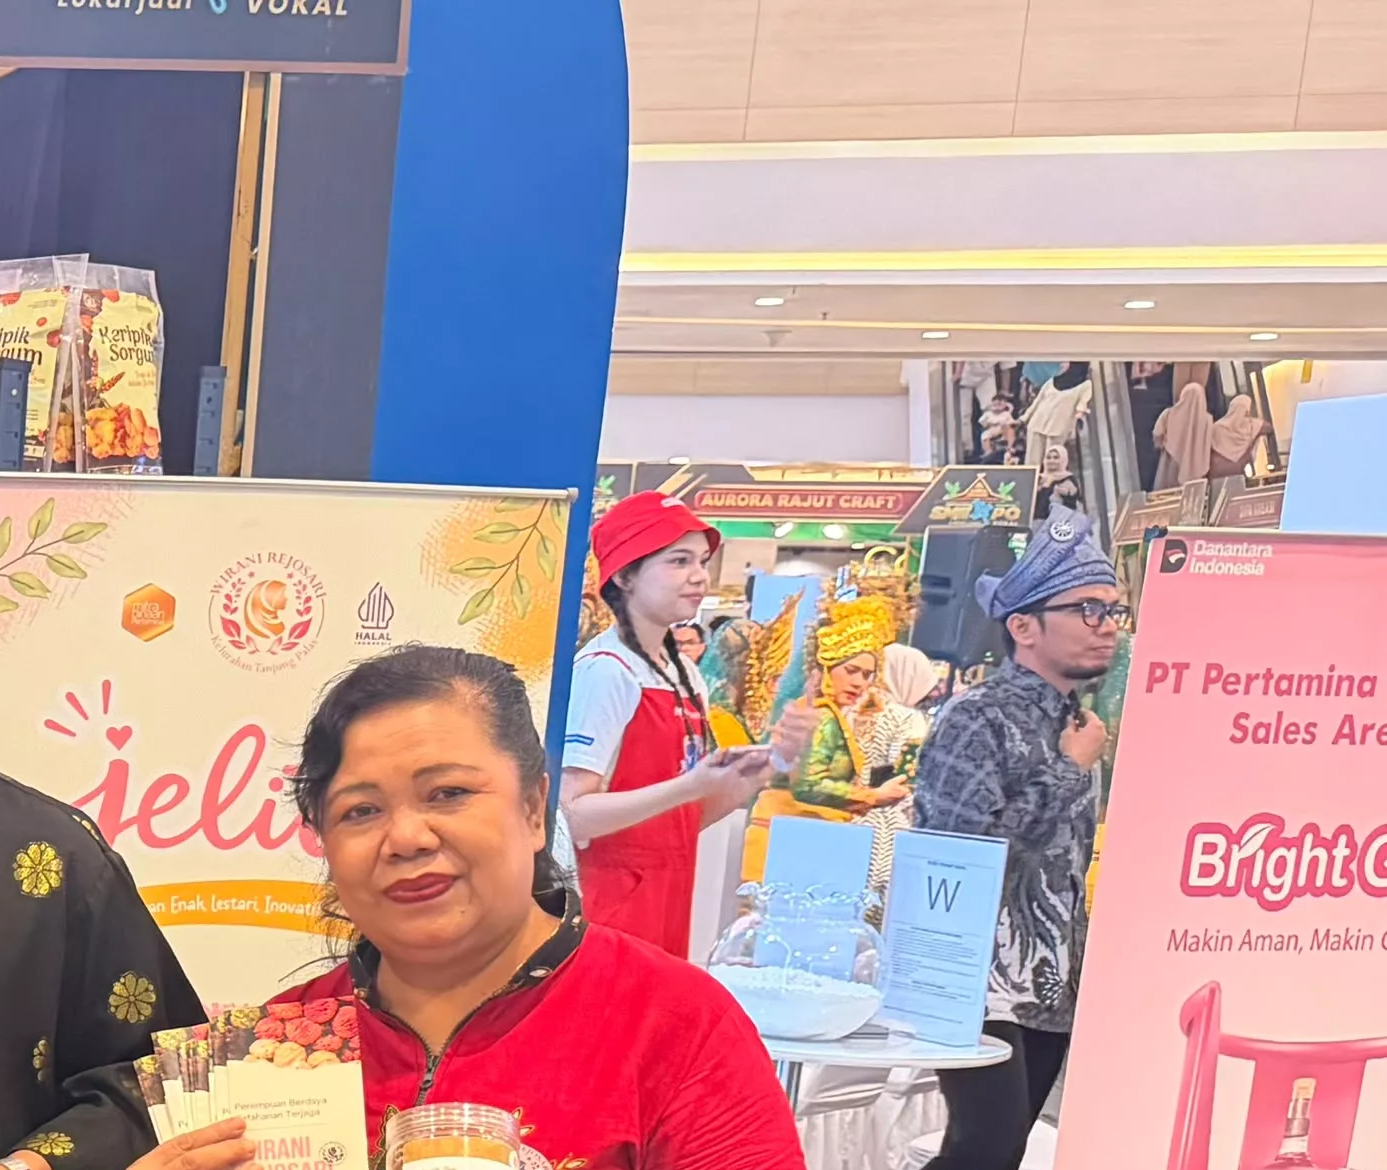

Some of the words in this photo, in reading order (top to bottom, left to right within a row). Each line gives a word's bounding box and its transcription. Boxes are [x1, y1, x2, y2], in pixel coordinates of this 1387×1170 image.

[701, 494, 774, 508] AURORA
[777, 494, 835, 508] RAJUT
[838, 495, 897, 509] CRAFT
[1193, 540, 1273, 558] Danantara
[210, 552, 264, 596] WIRANI
[267, 551, 328, 599] REJOSARI
[1189, 557, 1265, 576] Indonesia
[355, 632, 392, 642] HALAL
[1145, 661, 1190, 694] PT
[1202, 663, 1378, 698] Pertamina
[1229, 711, 1318, 745] Sales
[71, 724, 324, 857] jeli
[1185, 820, 1352, 905] Bright
[171, 894, 207, 914] Enak
[927, 875, 962, 913] W
[1167, 928, 1233, 953] Makin
[1238, 928, 1304, 955] Aman,
[1309, 927, 1375, 952] Makin
[255, 1136, 312, 1161] IRANI
